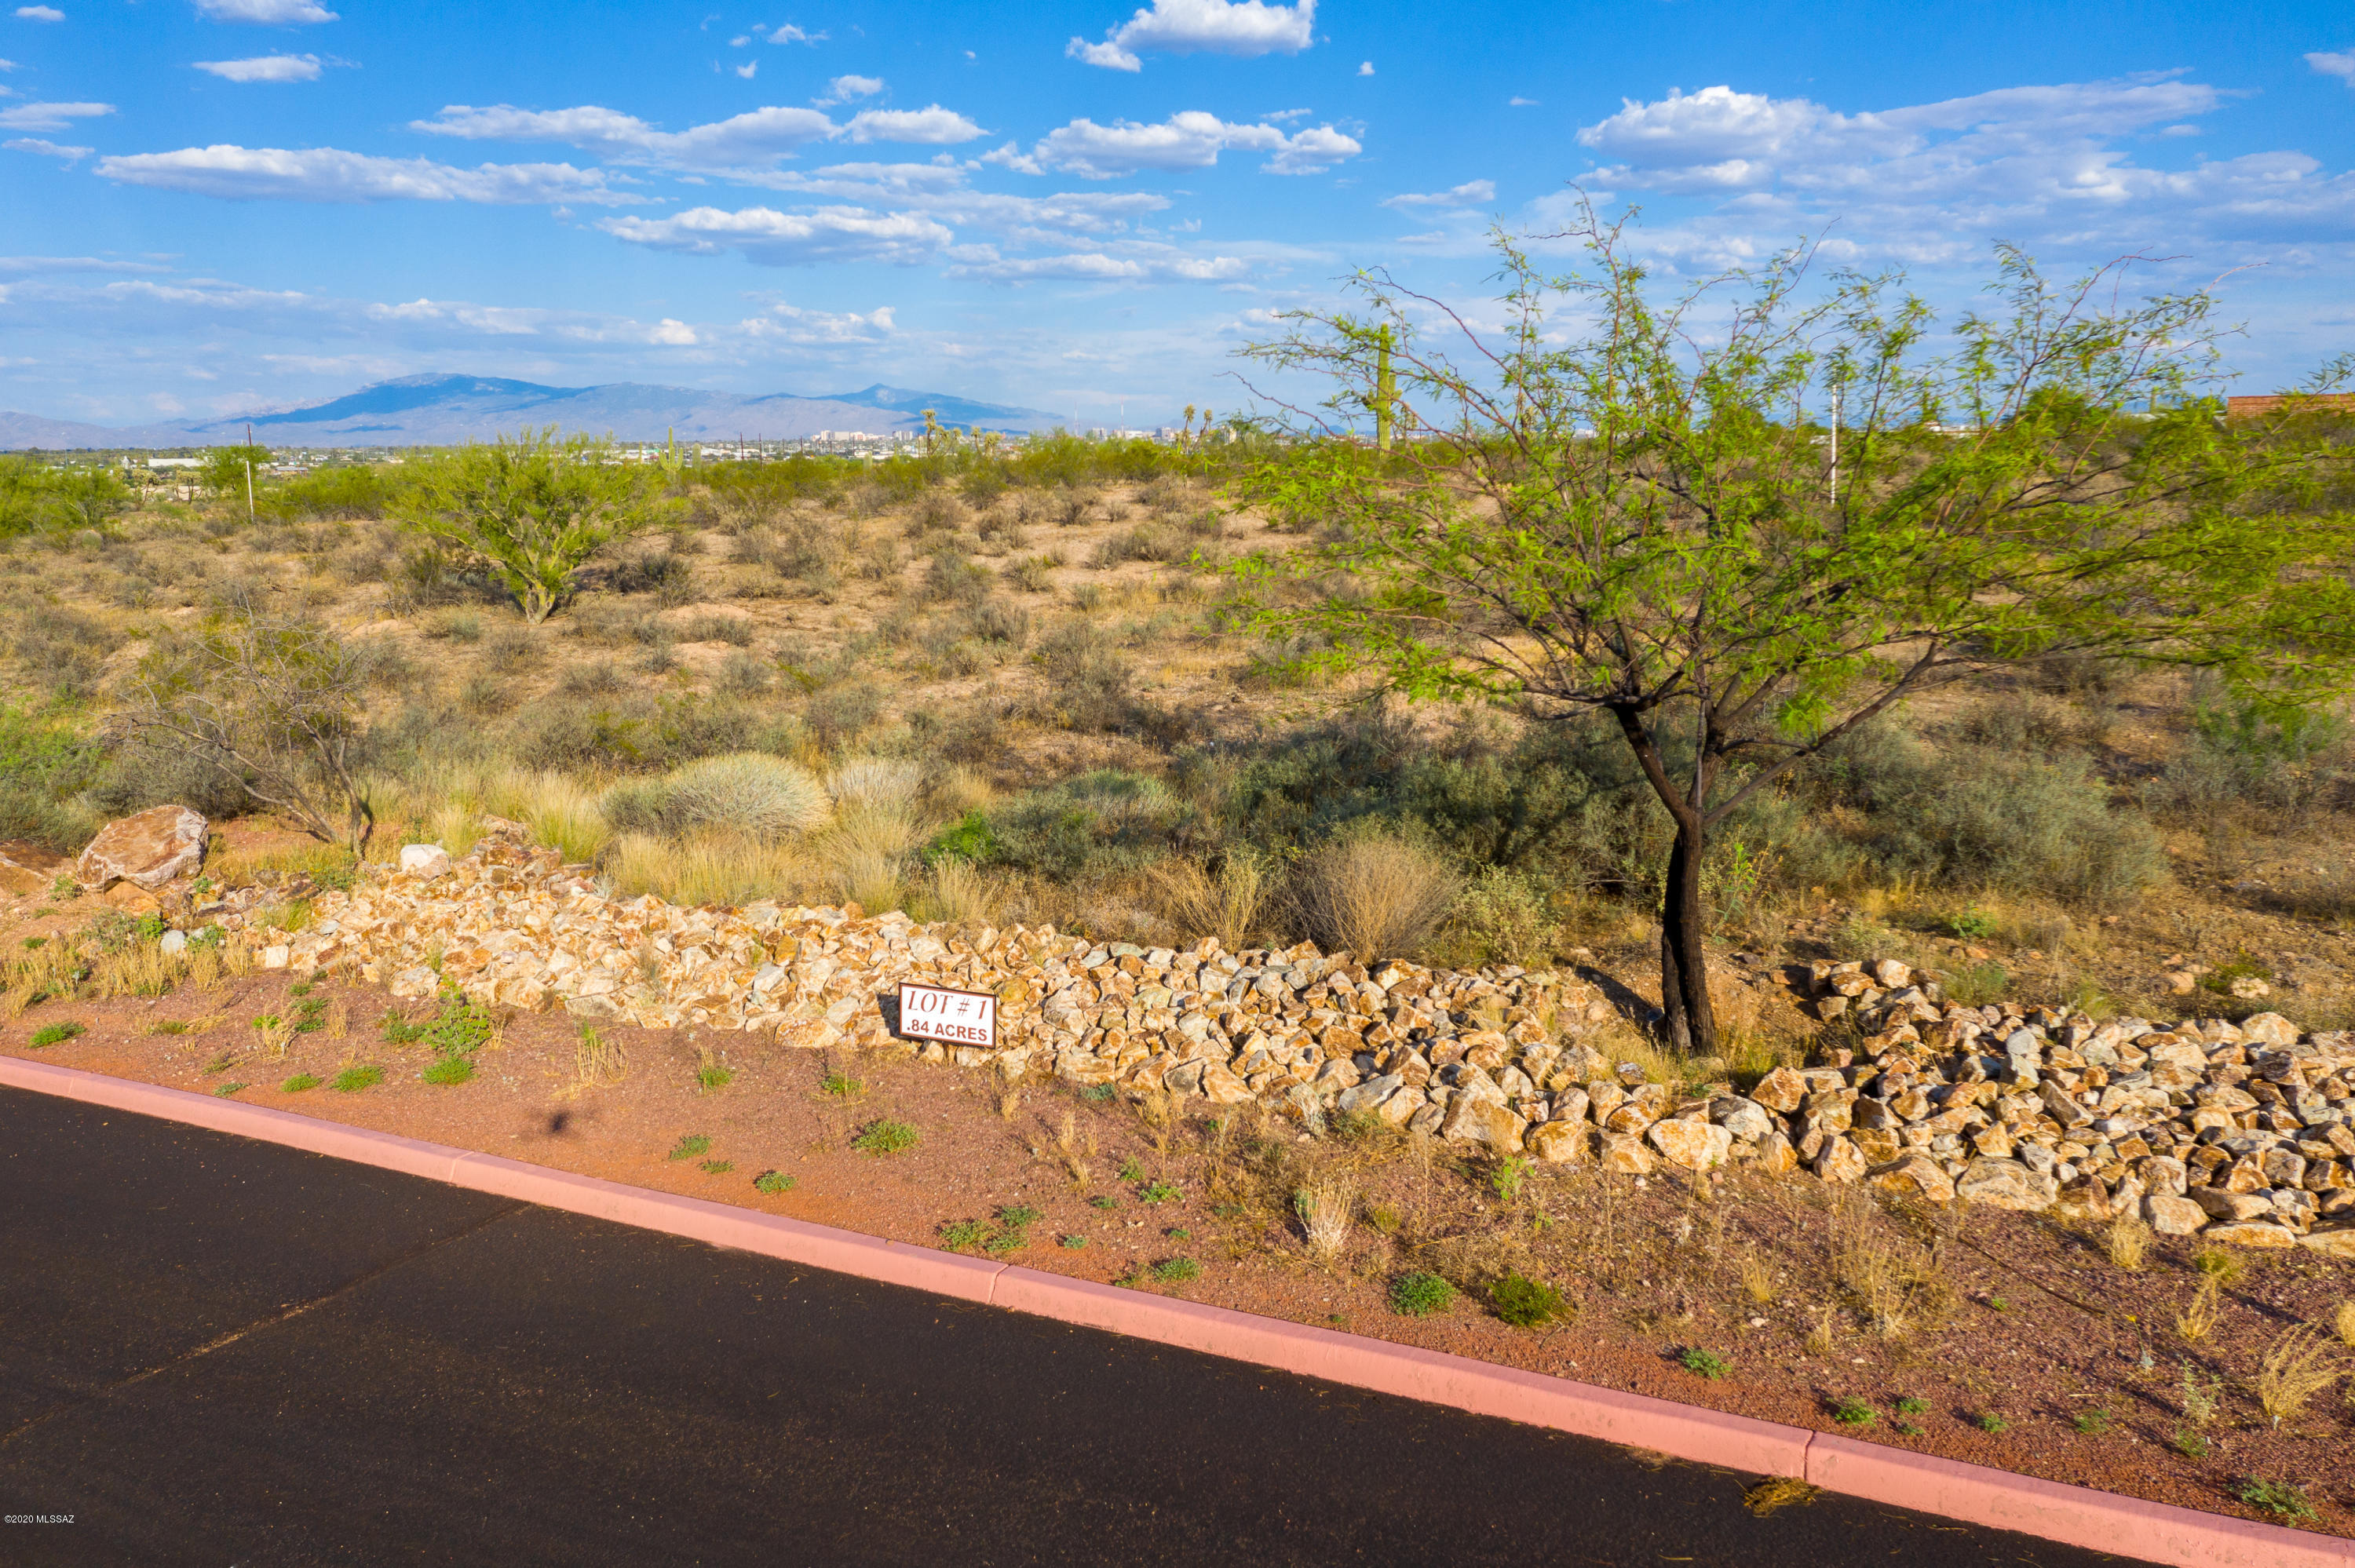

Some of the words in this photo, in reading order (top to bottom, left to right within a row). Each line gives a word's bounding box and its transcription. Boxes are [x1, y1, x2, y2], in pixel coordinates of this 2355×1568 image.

[907, 990, 953, 1014] LOT
[907, 1019, 929, 1034] .84
[934, 1023, 988, 1041] ACRES
